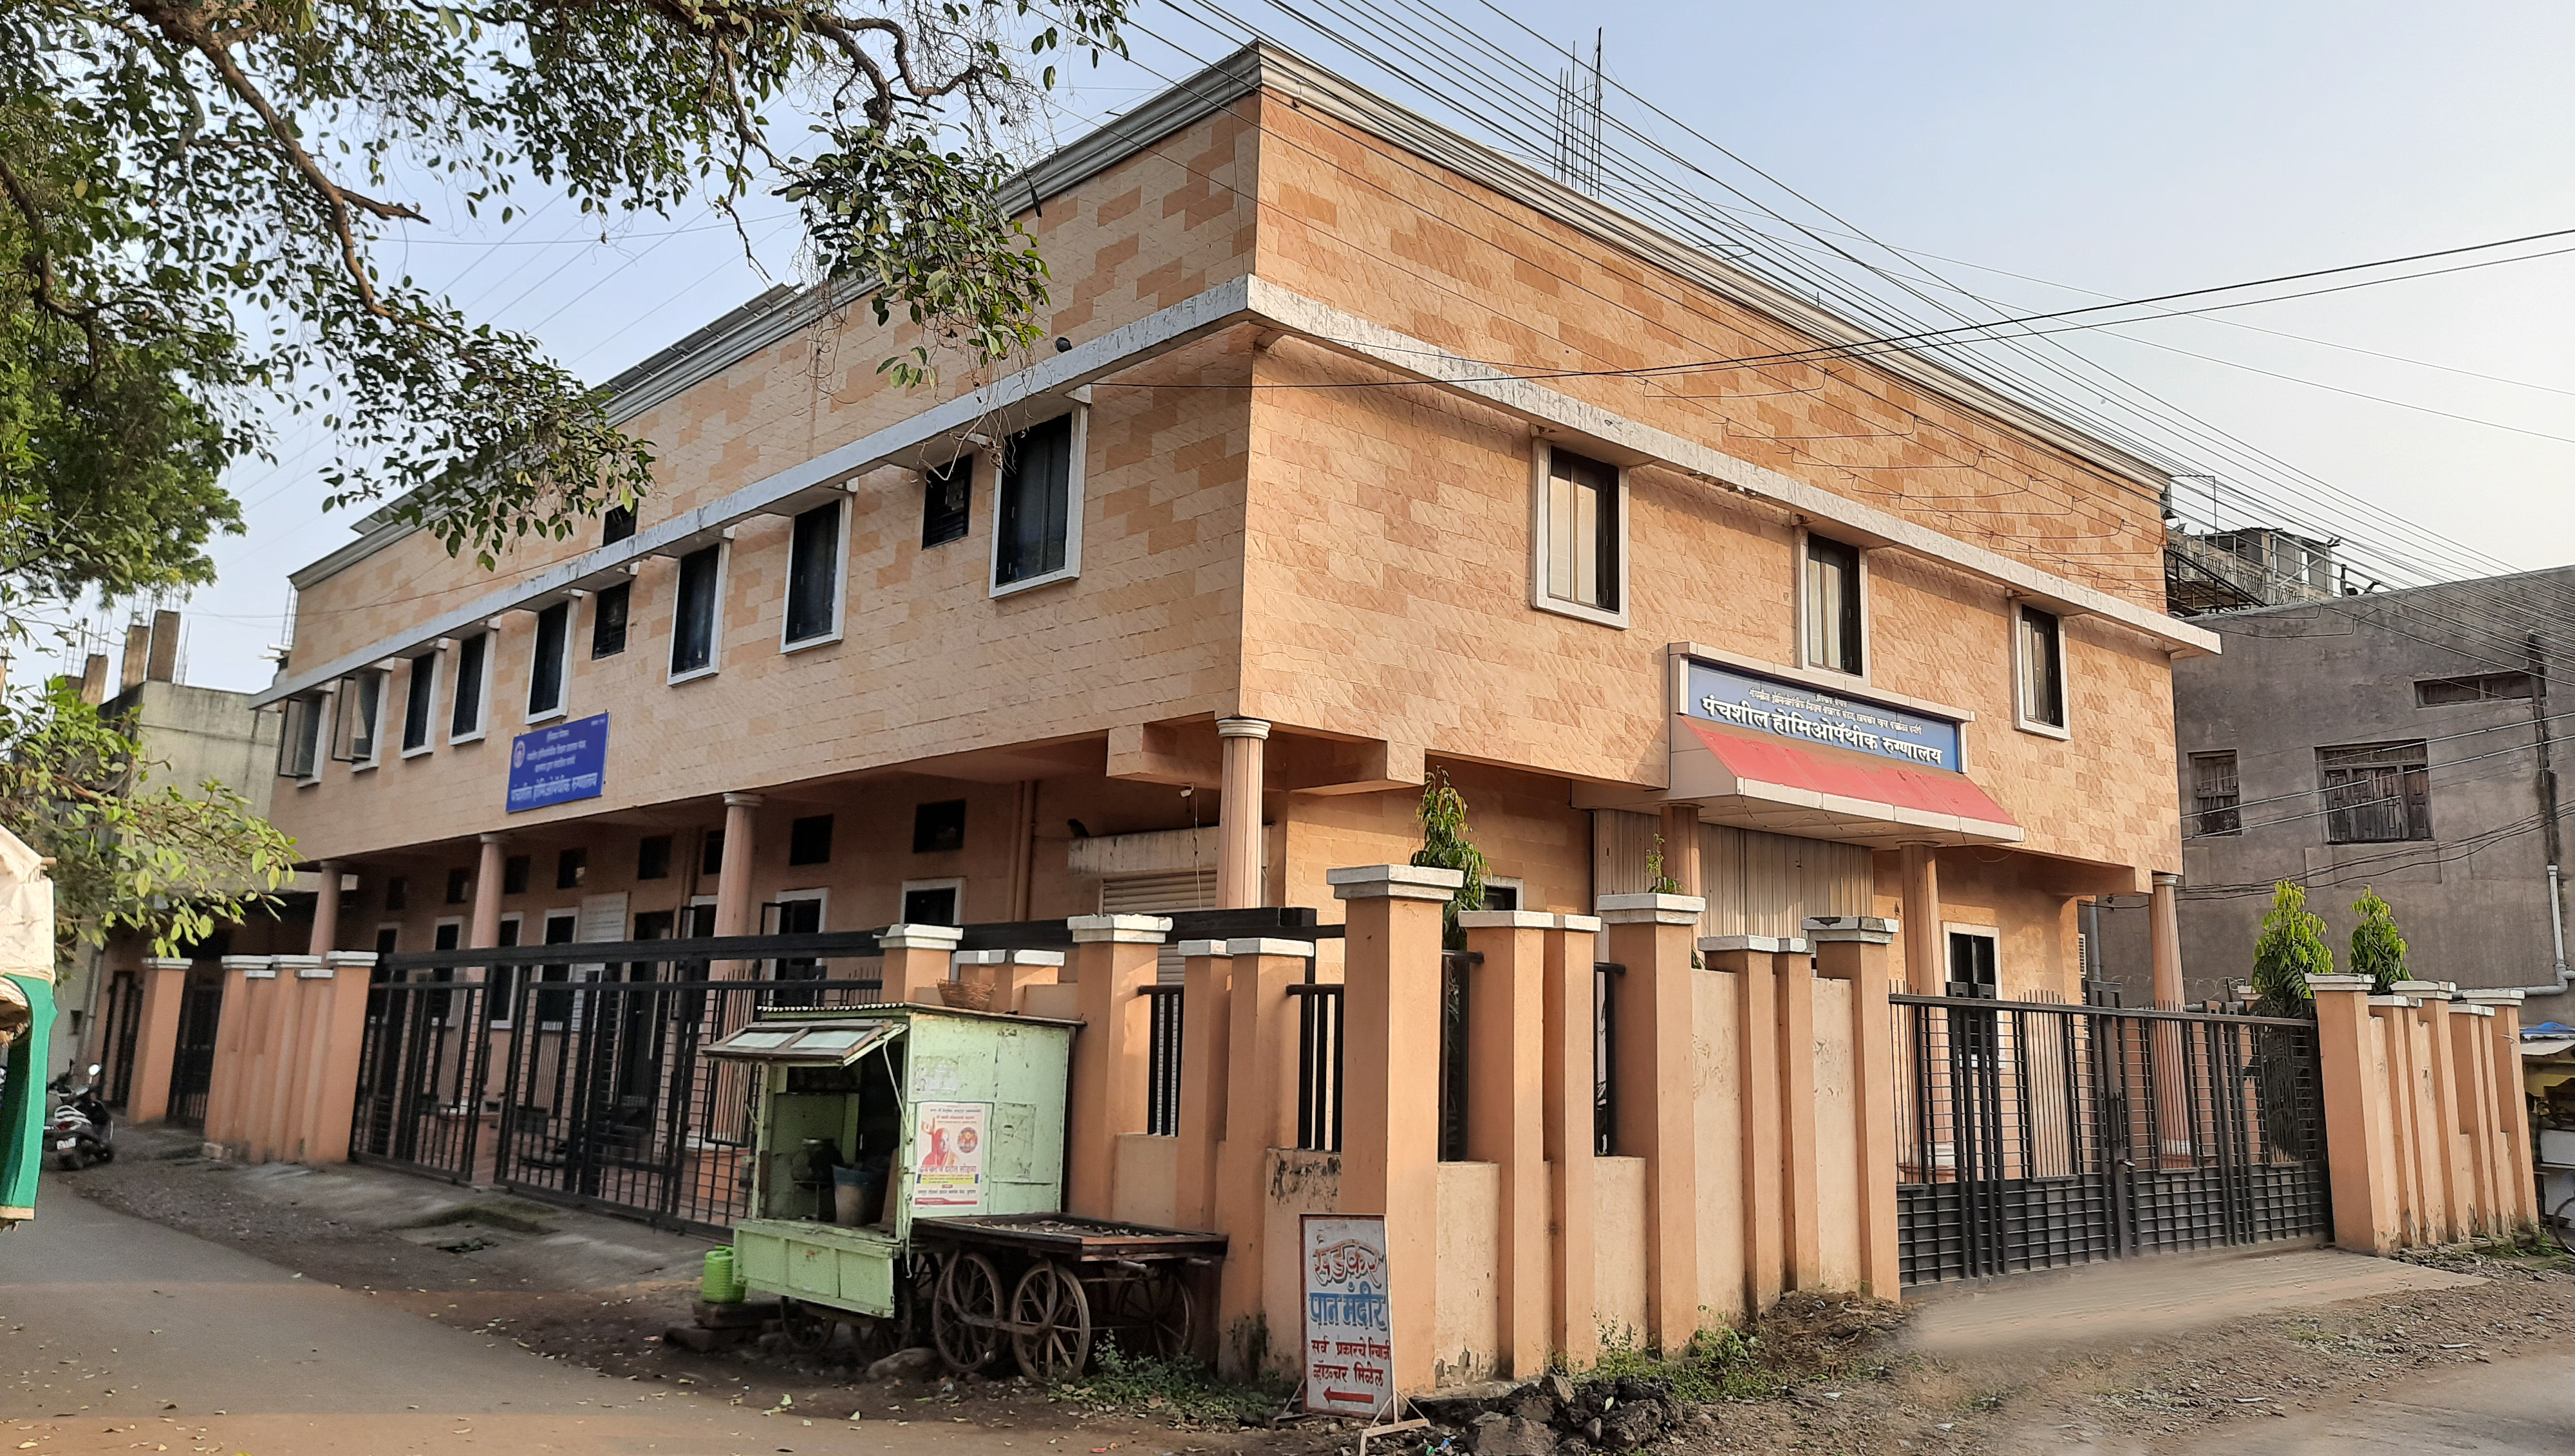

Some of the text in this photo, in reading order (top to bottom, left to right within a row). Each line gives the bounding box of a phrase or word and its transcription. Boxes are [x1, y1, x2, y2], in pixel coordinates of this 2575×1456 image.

[1701, 693, 1943, 765] पंचशील होमिओपॅथीक रुग्णालय
[1309, 1280, 1387, 1332] पान मंदीर
[1311, 1335, 1330, 1354] सर्व
[1335, 1336, 1366, 1358] प्रकारचे
[1353, 1361, 1383, 1386] मिळेल
